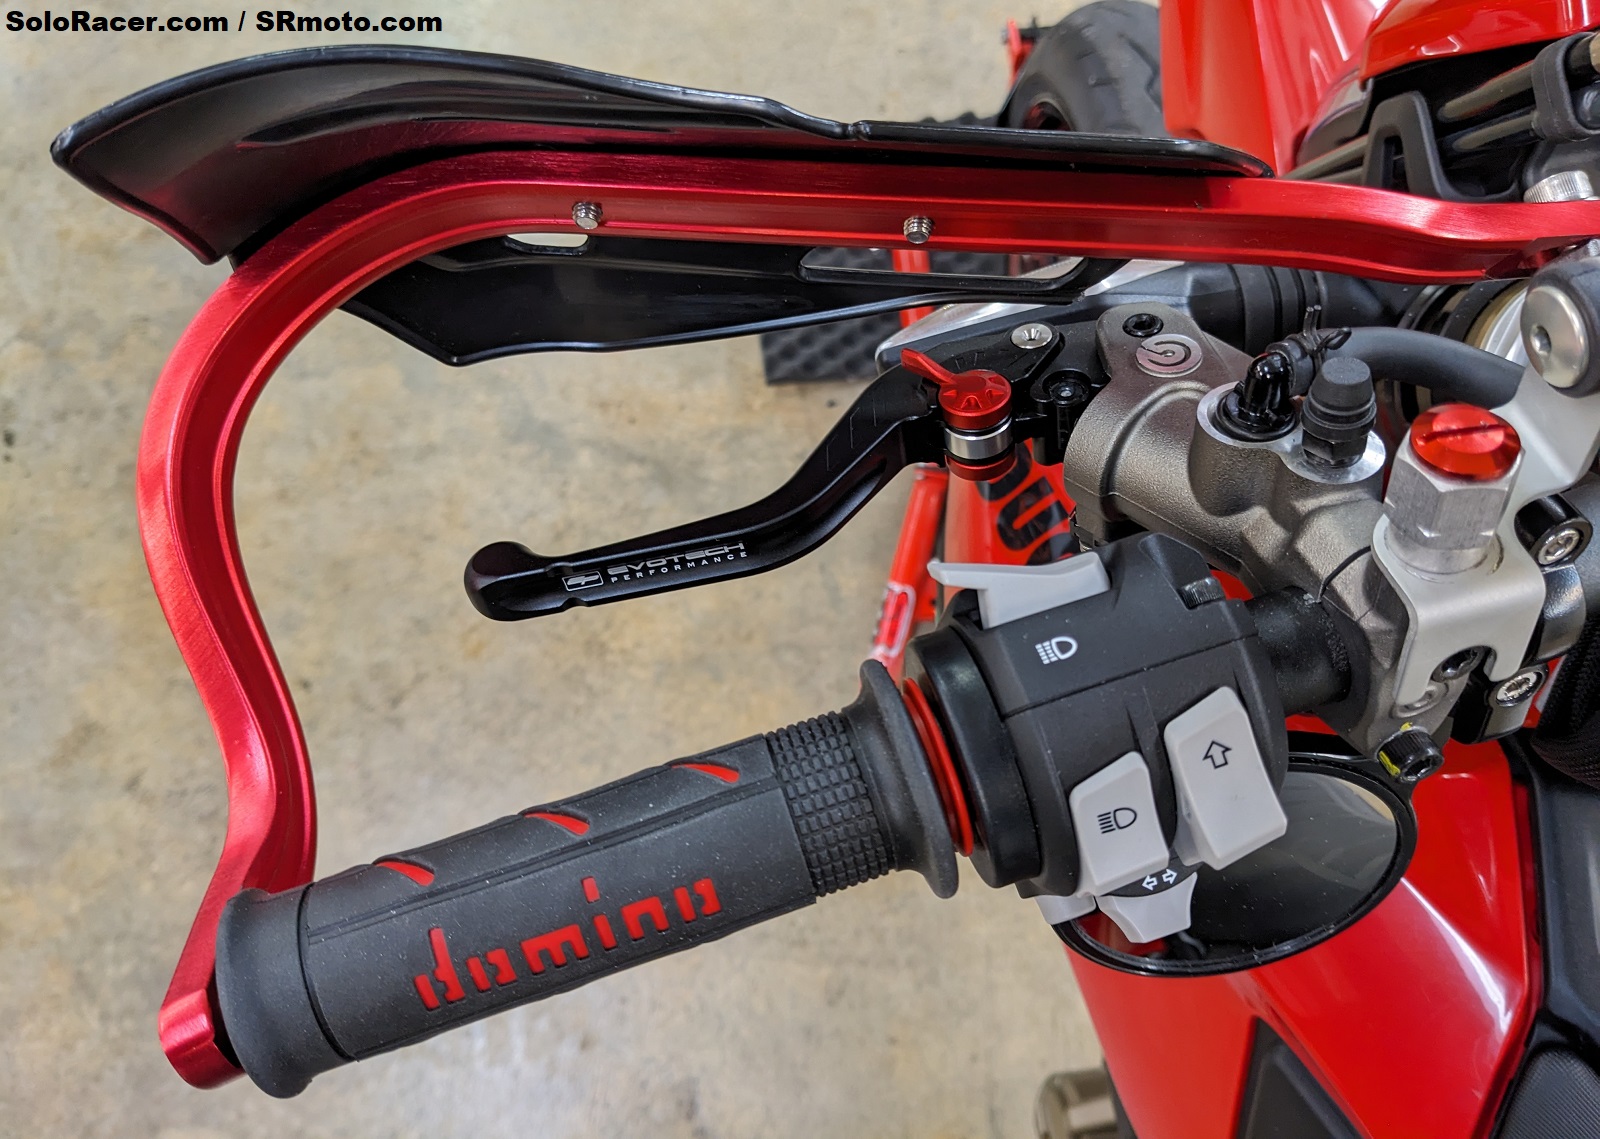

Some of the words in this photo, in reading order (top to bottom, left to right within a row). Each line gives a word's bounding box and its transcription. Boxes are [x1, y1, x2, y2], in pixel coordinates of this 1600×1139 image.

[606, 542, 745, 576] EVOTECH
[611, 551, 748, 583] PERFORMANCE
[413, 876, 722, 1011] domino
